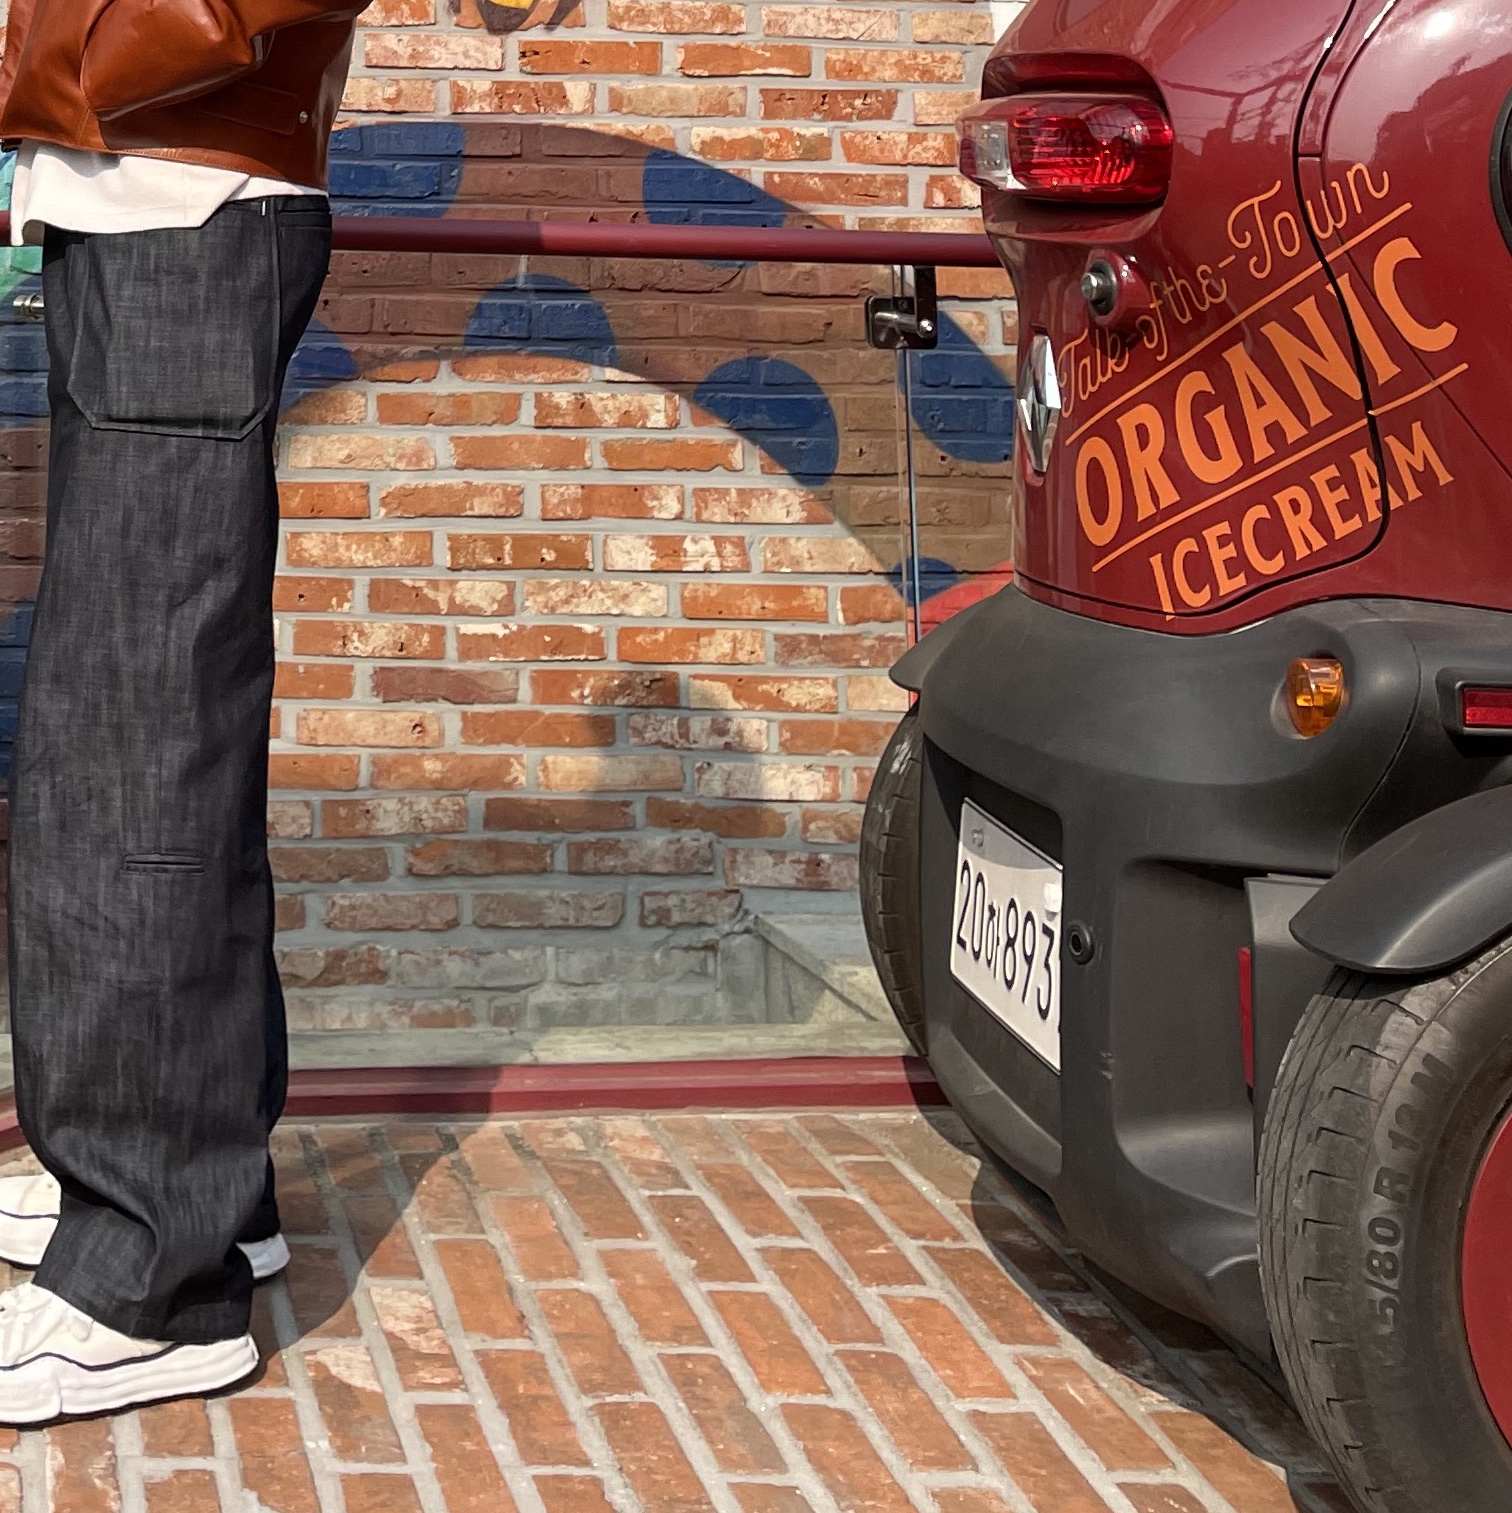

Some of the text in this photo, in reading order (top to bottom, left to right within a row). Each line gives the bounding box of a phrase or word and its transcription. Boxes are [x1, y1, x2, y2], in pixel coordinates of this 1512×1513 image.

[1075, 236, 1458, 547] ORGANIC
[1148, 420, 1455, 621] ICECREAM
[956, 858, 1060, 1021] 20하893
